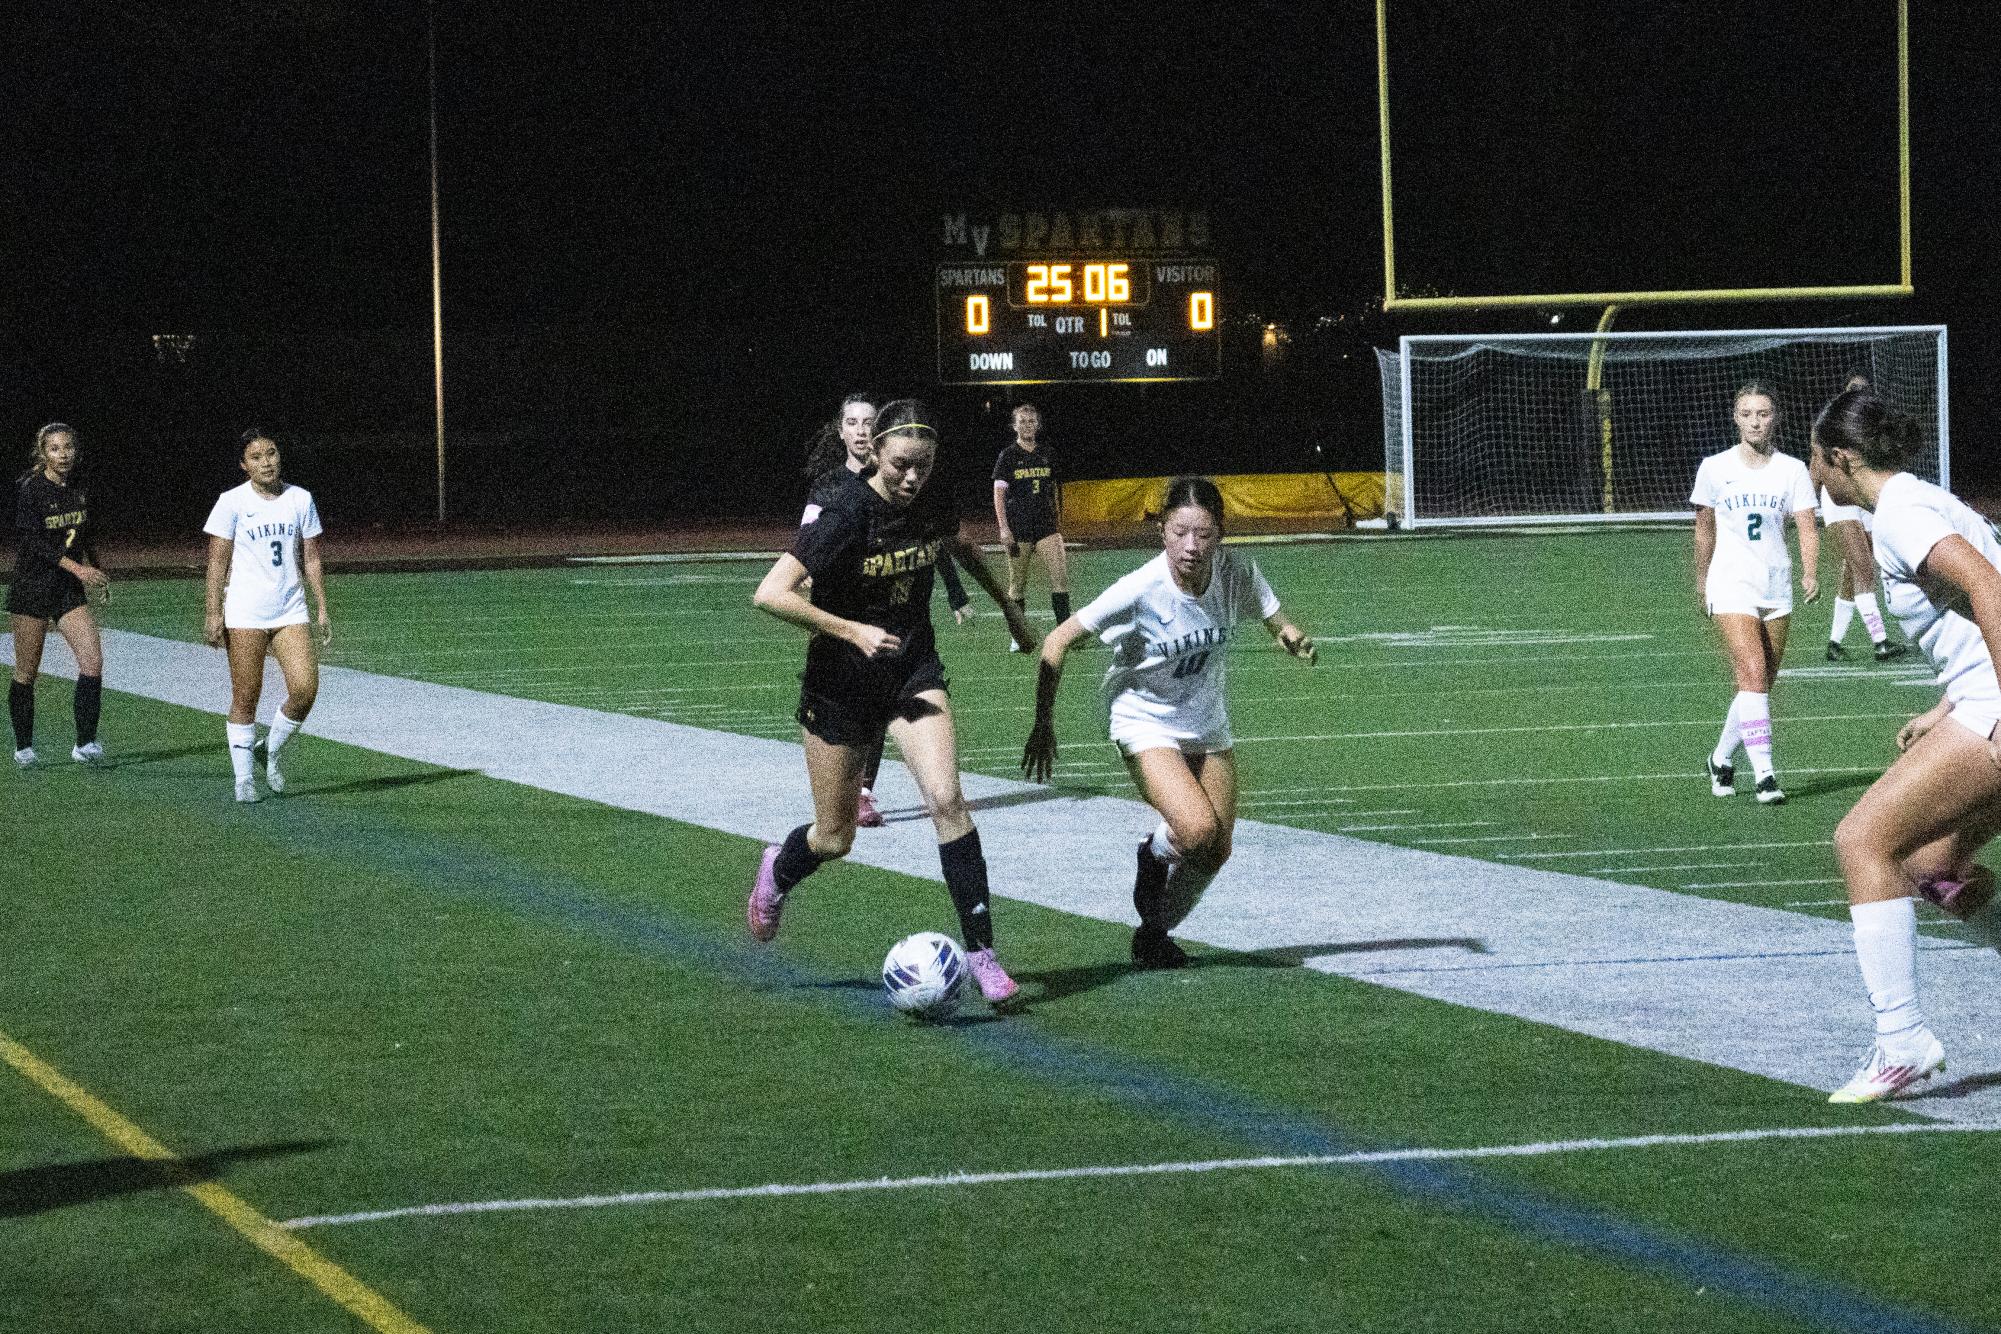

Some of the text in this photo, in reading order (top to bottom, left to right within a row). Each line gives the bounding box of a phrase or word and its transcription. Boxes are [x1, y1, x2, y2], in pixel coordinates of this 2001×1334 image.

[999, 208, 1210, 248] SPARTANS
[939, 268, 1006, 287] SPARTANS
[1156, 265, 1215, 283] VISITOR
[966, 294, 990, 334] 0
[1113, 313, 1132, 326] TOL
[1189, 291, 1214, 331] 0
[1028, 314, 1047, 327] TOL
[1055, 316, 1084, 334] QTR
[970, 353, 1013, 370] DOWN
[1145, 349, 1168, 367] ON
[1032, 479, 1040, 494] 3
[1724, 492, 1787, 512] VIKINGS
[1747, 513, 1763, 541] 2
[270, 540, 283, 567] 3
